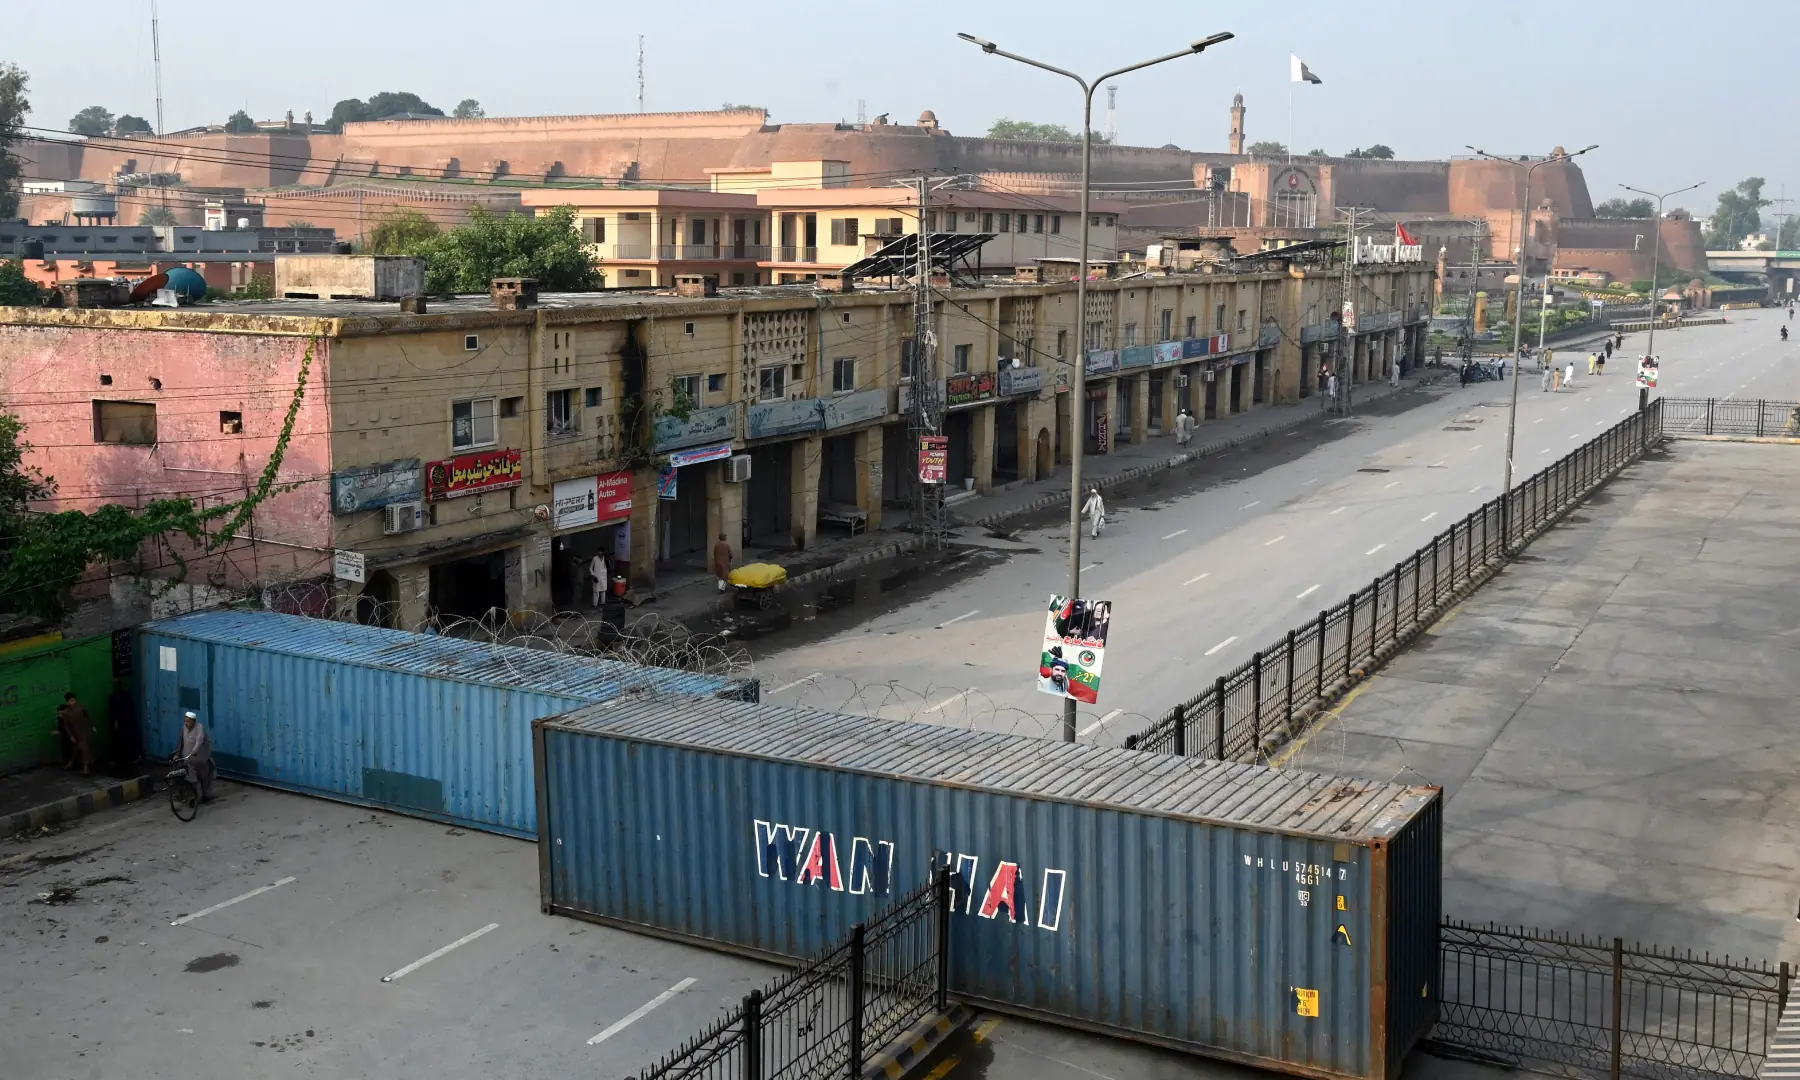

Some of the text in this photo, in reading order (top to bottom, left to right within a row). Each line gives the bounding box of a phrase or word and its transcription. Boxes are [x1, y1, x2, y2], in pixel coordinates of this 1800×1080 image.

[599, 489, 616, 499] Autos
[1083, 672, 1096, 684] 27
[1244, 854, 1347, 881] WHLU 574514 7
[754, 819, 1067, 931] WAN HAI
[1295, 873, 1319, 886] 45G1
[1297, 990, 1316, 999] AUTION
